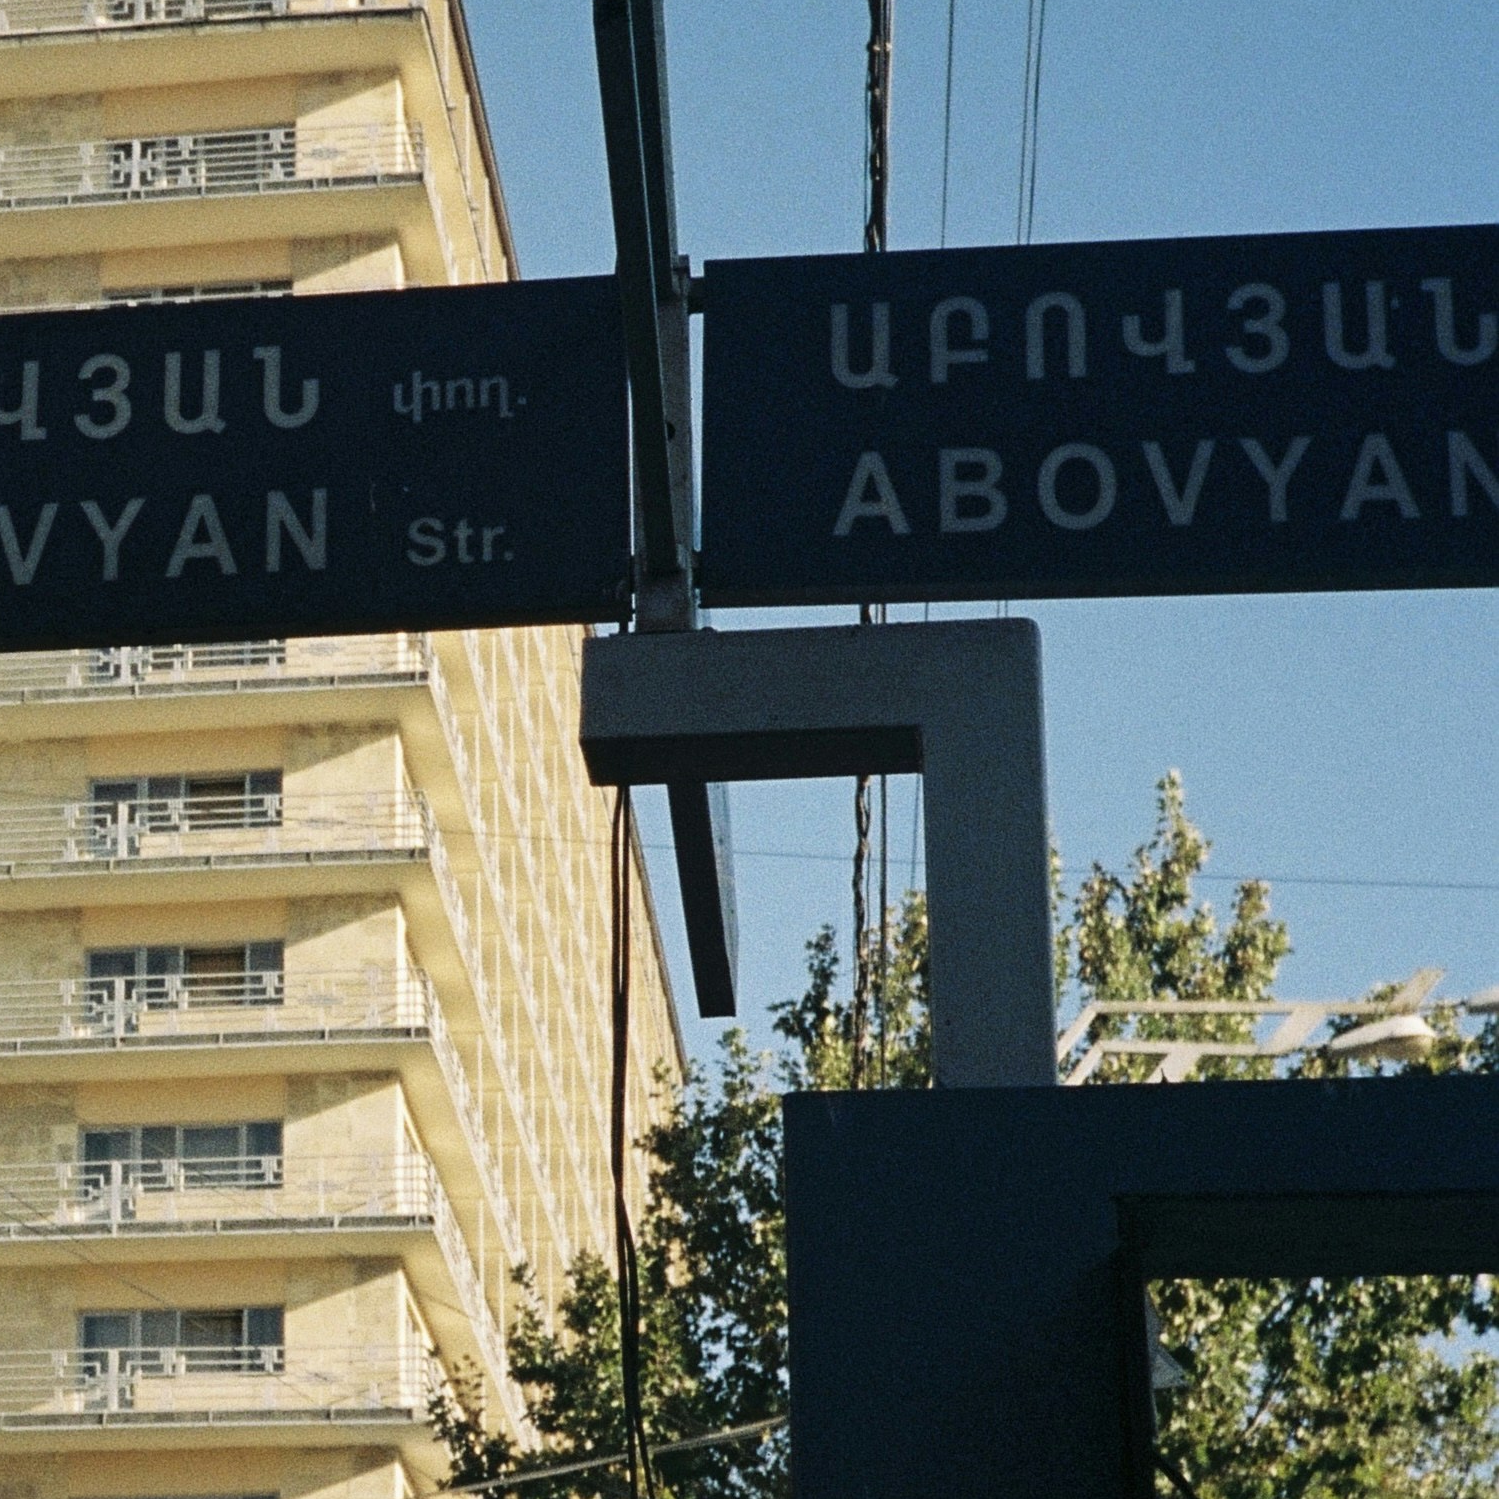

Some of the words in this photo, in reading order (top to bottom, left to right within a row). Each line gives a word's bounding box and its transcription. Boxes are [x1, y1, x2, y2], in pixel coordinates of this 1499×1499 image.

[830, 277, 1499, 390] ԱԲՈՎՅԱՆ
[831, 431, 1499, 537] ABOVYAN
[406, 515, 516, 568] Str.
